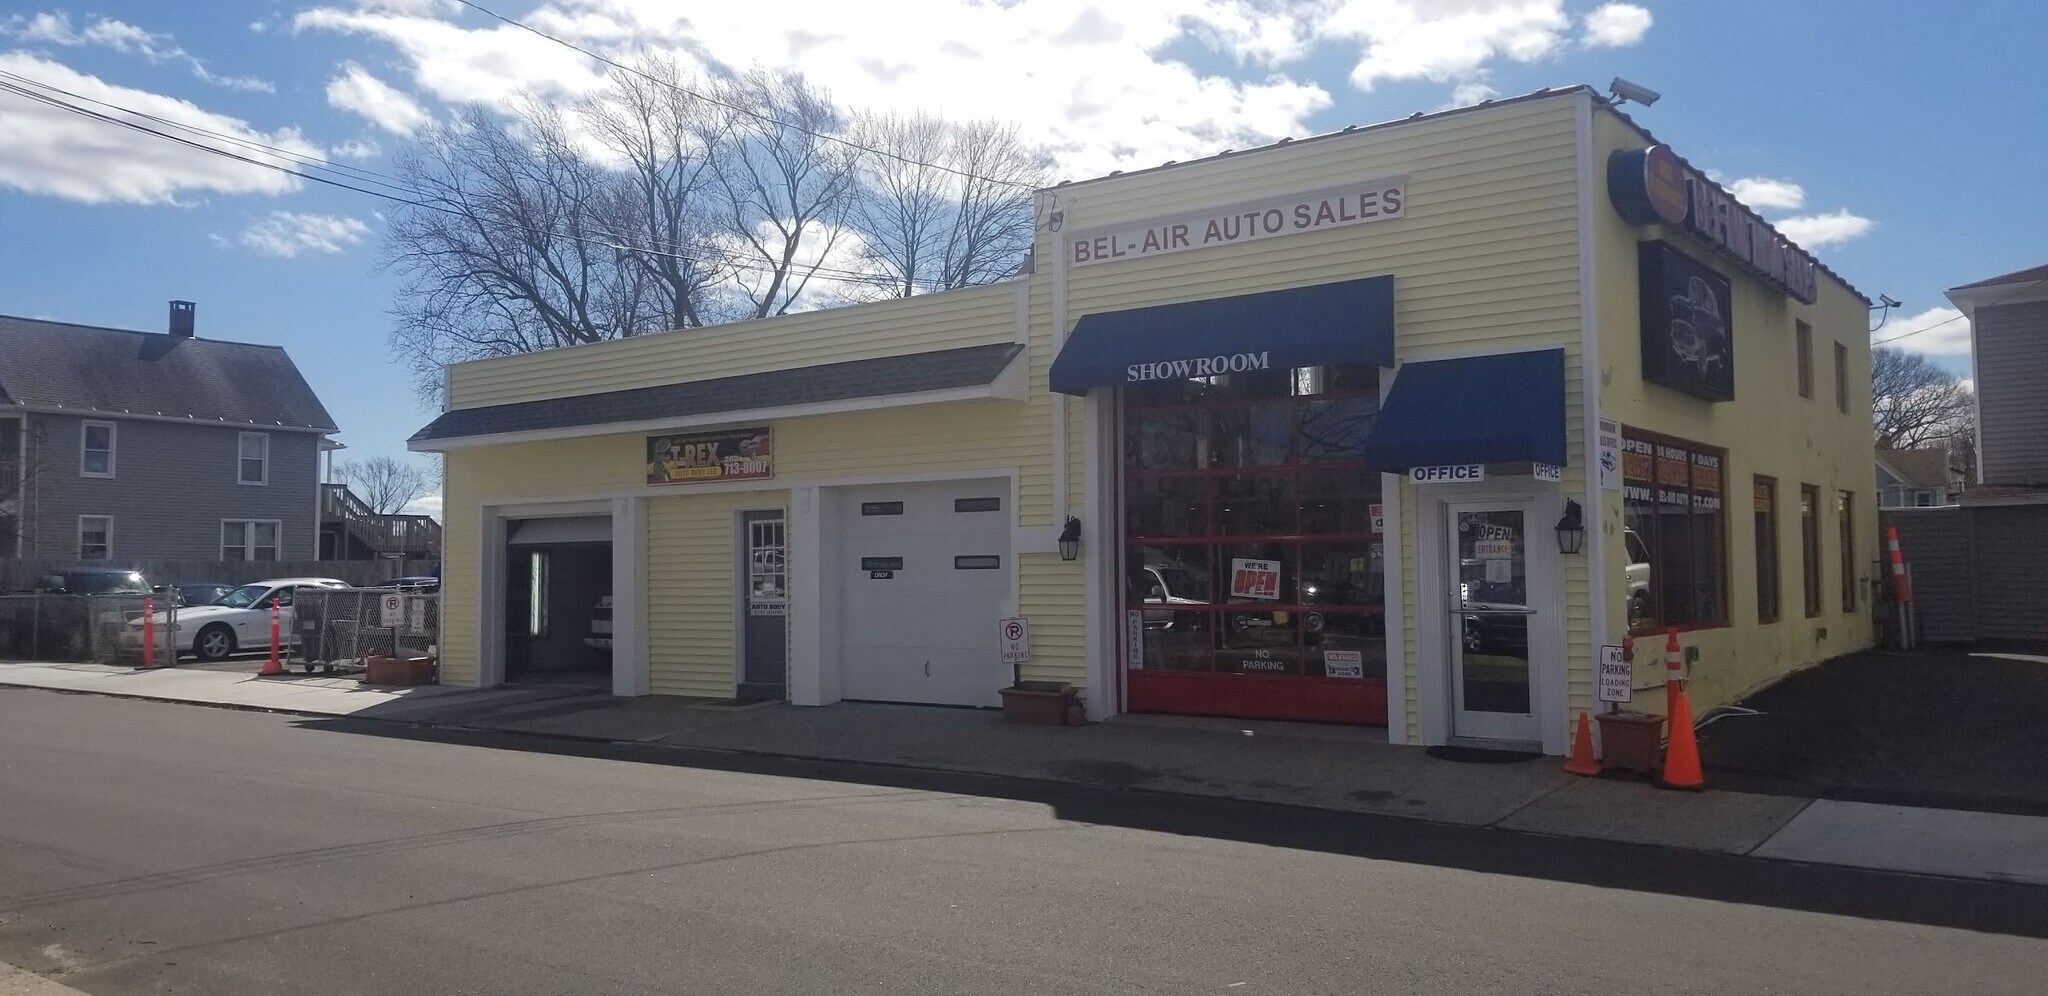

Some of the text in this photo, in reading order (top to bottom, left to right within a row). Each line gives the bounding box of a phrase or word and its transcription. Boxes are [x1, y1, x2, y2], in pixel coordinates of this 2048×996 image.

[1073, 188, 1402, 264] BEL-AIR AUTO SALES
[1127, 350, 1270, 382] SHOWROOM
[1620, 437, 1653, 455] OPEN
[1666, 446, 1688, 462] HOURS
[1698, 454, 1719, 468] DAYS
[724, 461, 767, 475] 713-8007
[1413, 465, 1480, 481] OFFICE
[1535, 463, 1560, 479] OFFICE
[1479, 525, 1512, 541] OPEN
[1477, 543, 1509, 554] ENTRANCE
[1244, 562, 1269, 570] WE'RE
[1234, 569, 1278, 596] OPEN
[1010, 643, 1020, 651] NO
[1003, 651, 1029, 660] PARKING
[1255, 649, 1270, 659] NO
[1327, 652, 1359, 662] WARNING
[1610, 651, 1622, 663] NO
[1242, 660, 1285, 671] PARKING
[1601, 663, 1631, 676] PARKING
[1601, 678, 1630, 688] LOADING
[1607, 688, 1625, 697] ZONE
